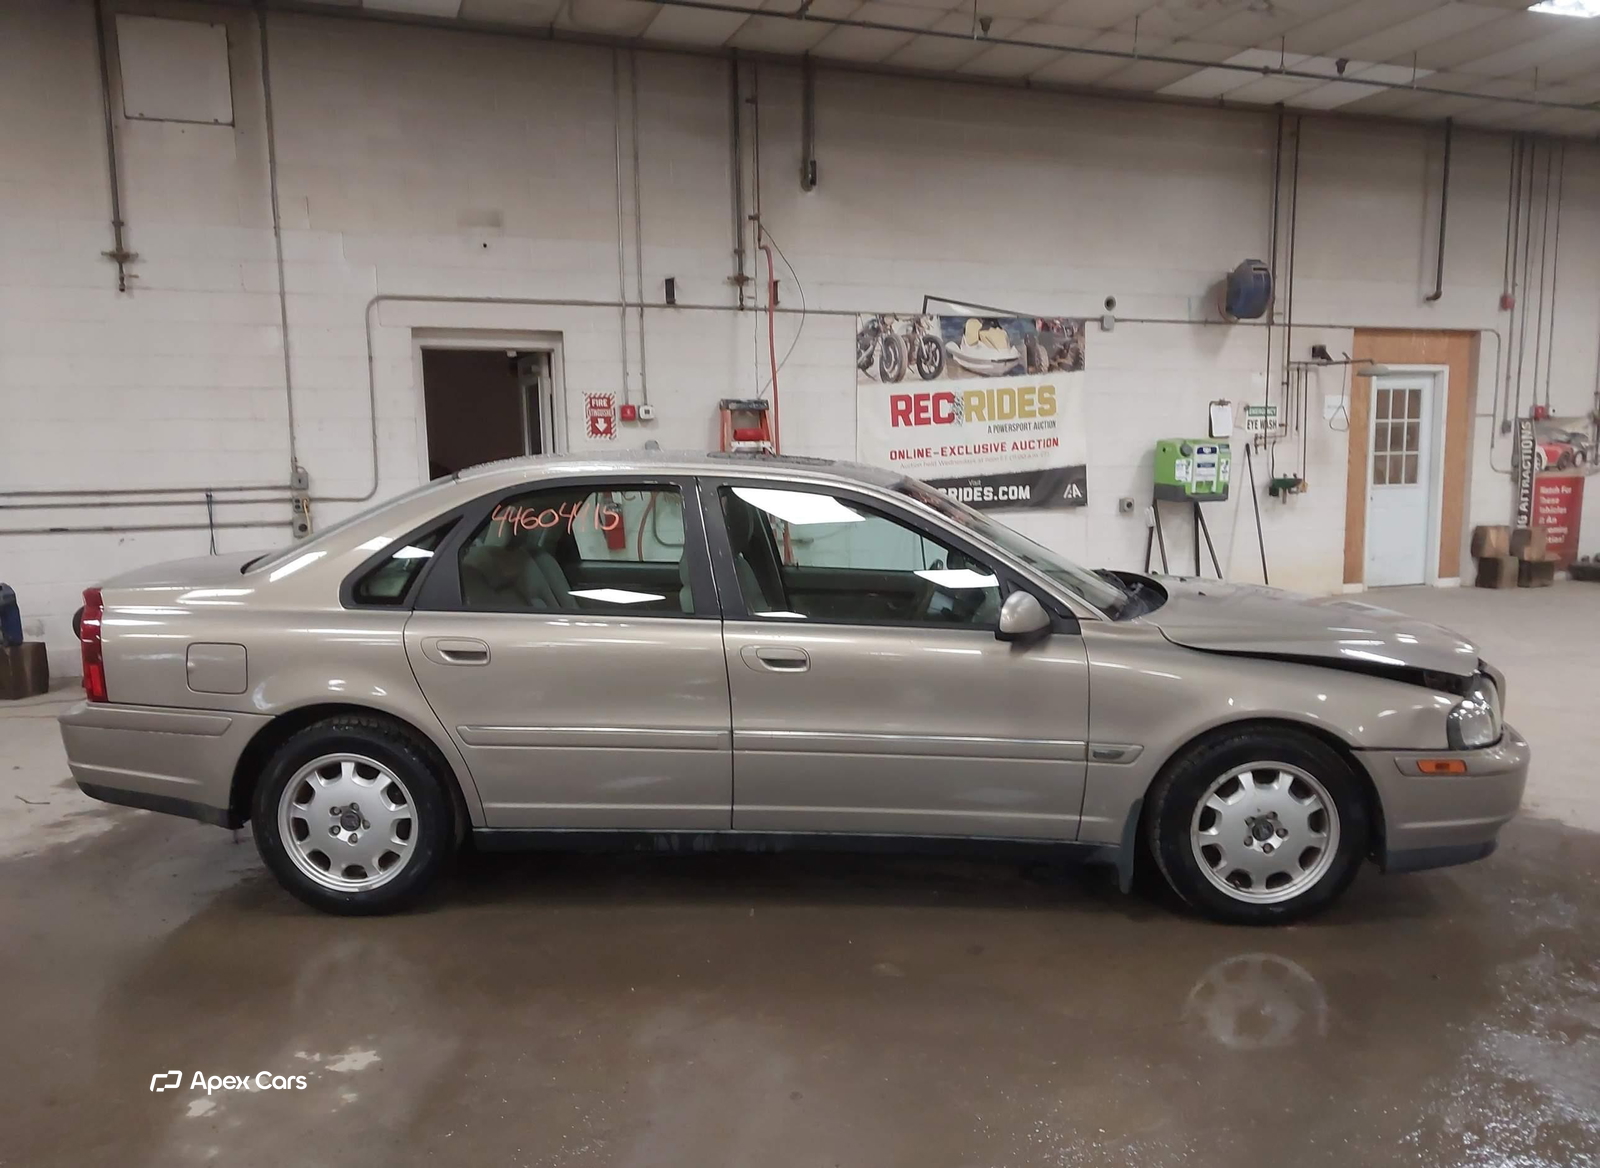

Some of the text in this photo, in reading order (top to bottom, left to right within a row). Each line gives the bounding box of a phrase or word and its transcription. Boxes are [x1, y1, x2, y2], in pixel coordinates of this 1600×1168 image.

[591, 398, 608, 407] FIRE
[890, 385, 1057, 428] REC RIDES
[988, 420, 1056, 434] A POWERSPORT AUCTION
[1247, 419, 1258, 430] EYE
[889, 437, 1059, 461] ONLINE-EXCLUSIVE AUCTION
[1519, 421, 1533, 512] ATTRACTIONS
